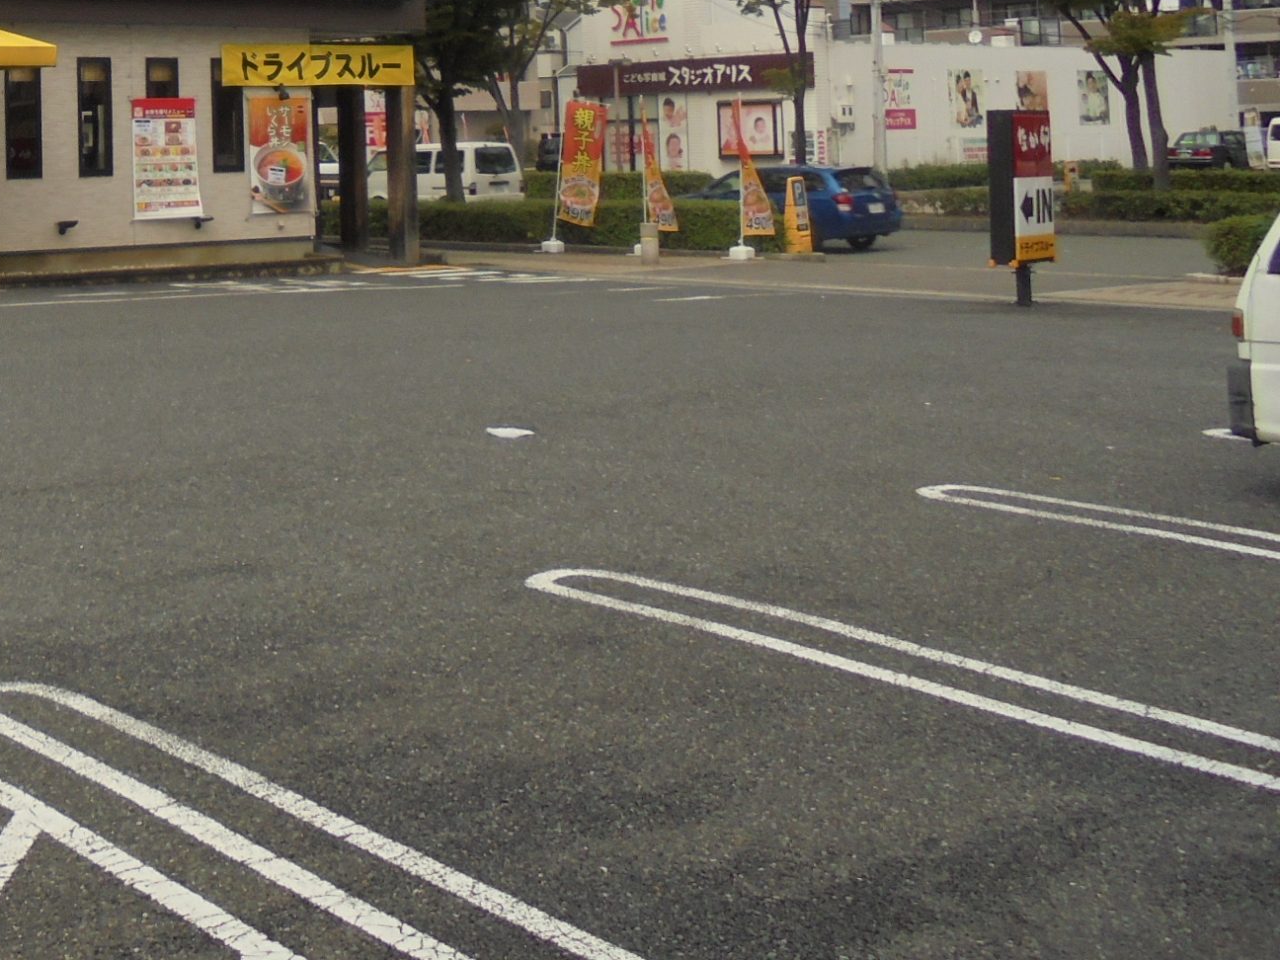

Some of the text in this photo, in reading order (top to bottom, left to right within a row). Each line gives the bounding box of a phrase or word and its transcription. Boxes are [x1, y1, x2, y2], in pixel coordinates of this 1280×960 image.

[241, 51, 401, 81] ドライブスルー
[668, 64, 753, 86] スタジオアリス
[573, 107, 595, 173] 親子丼
[1036, 188, 1053, 224] IN
